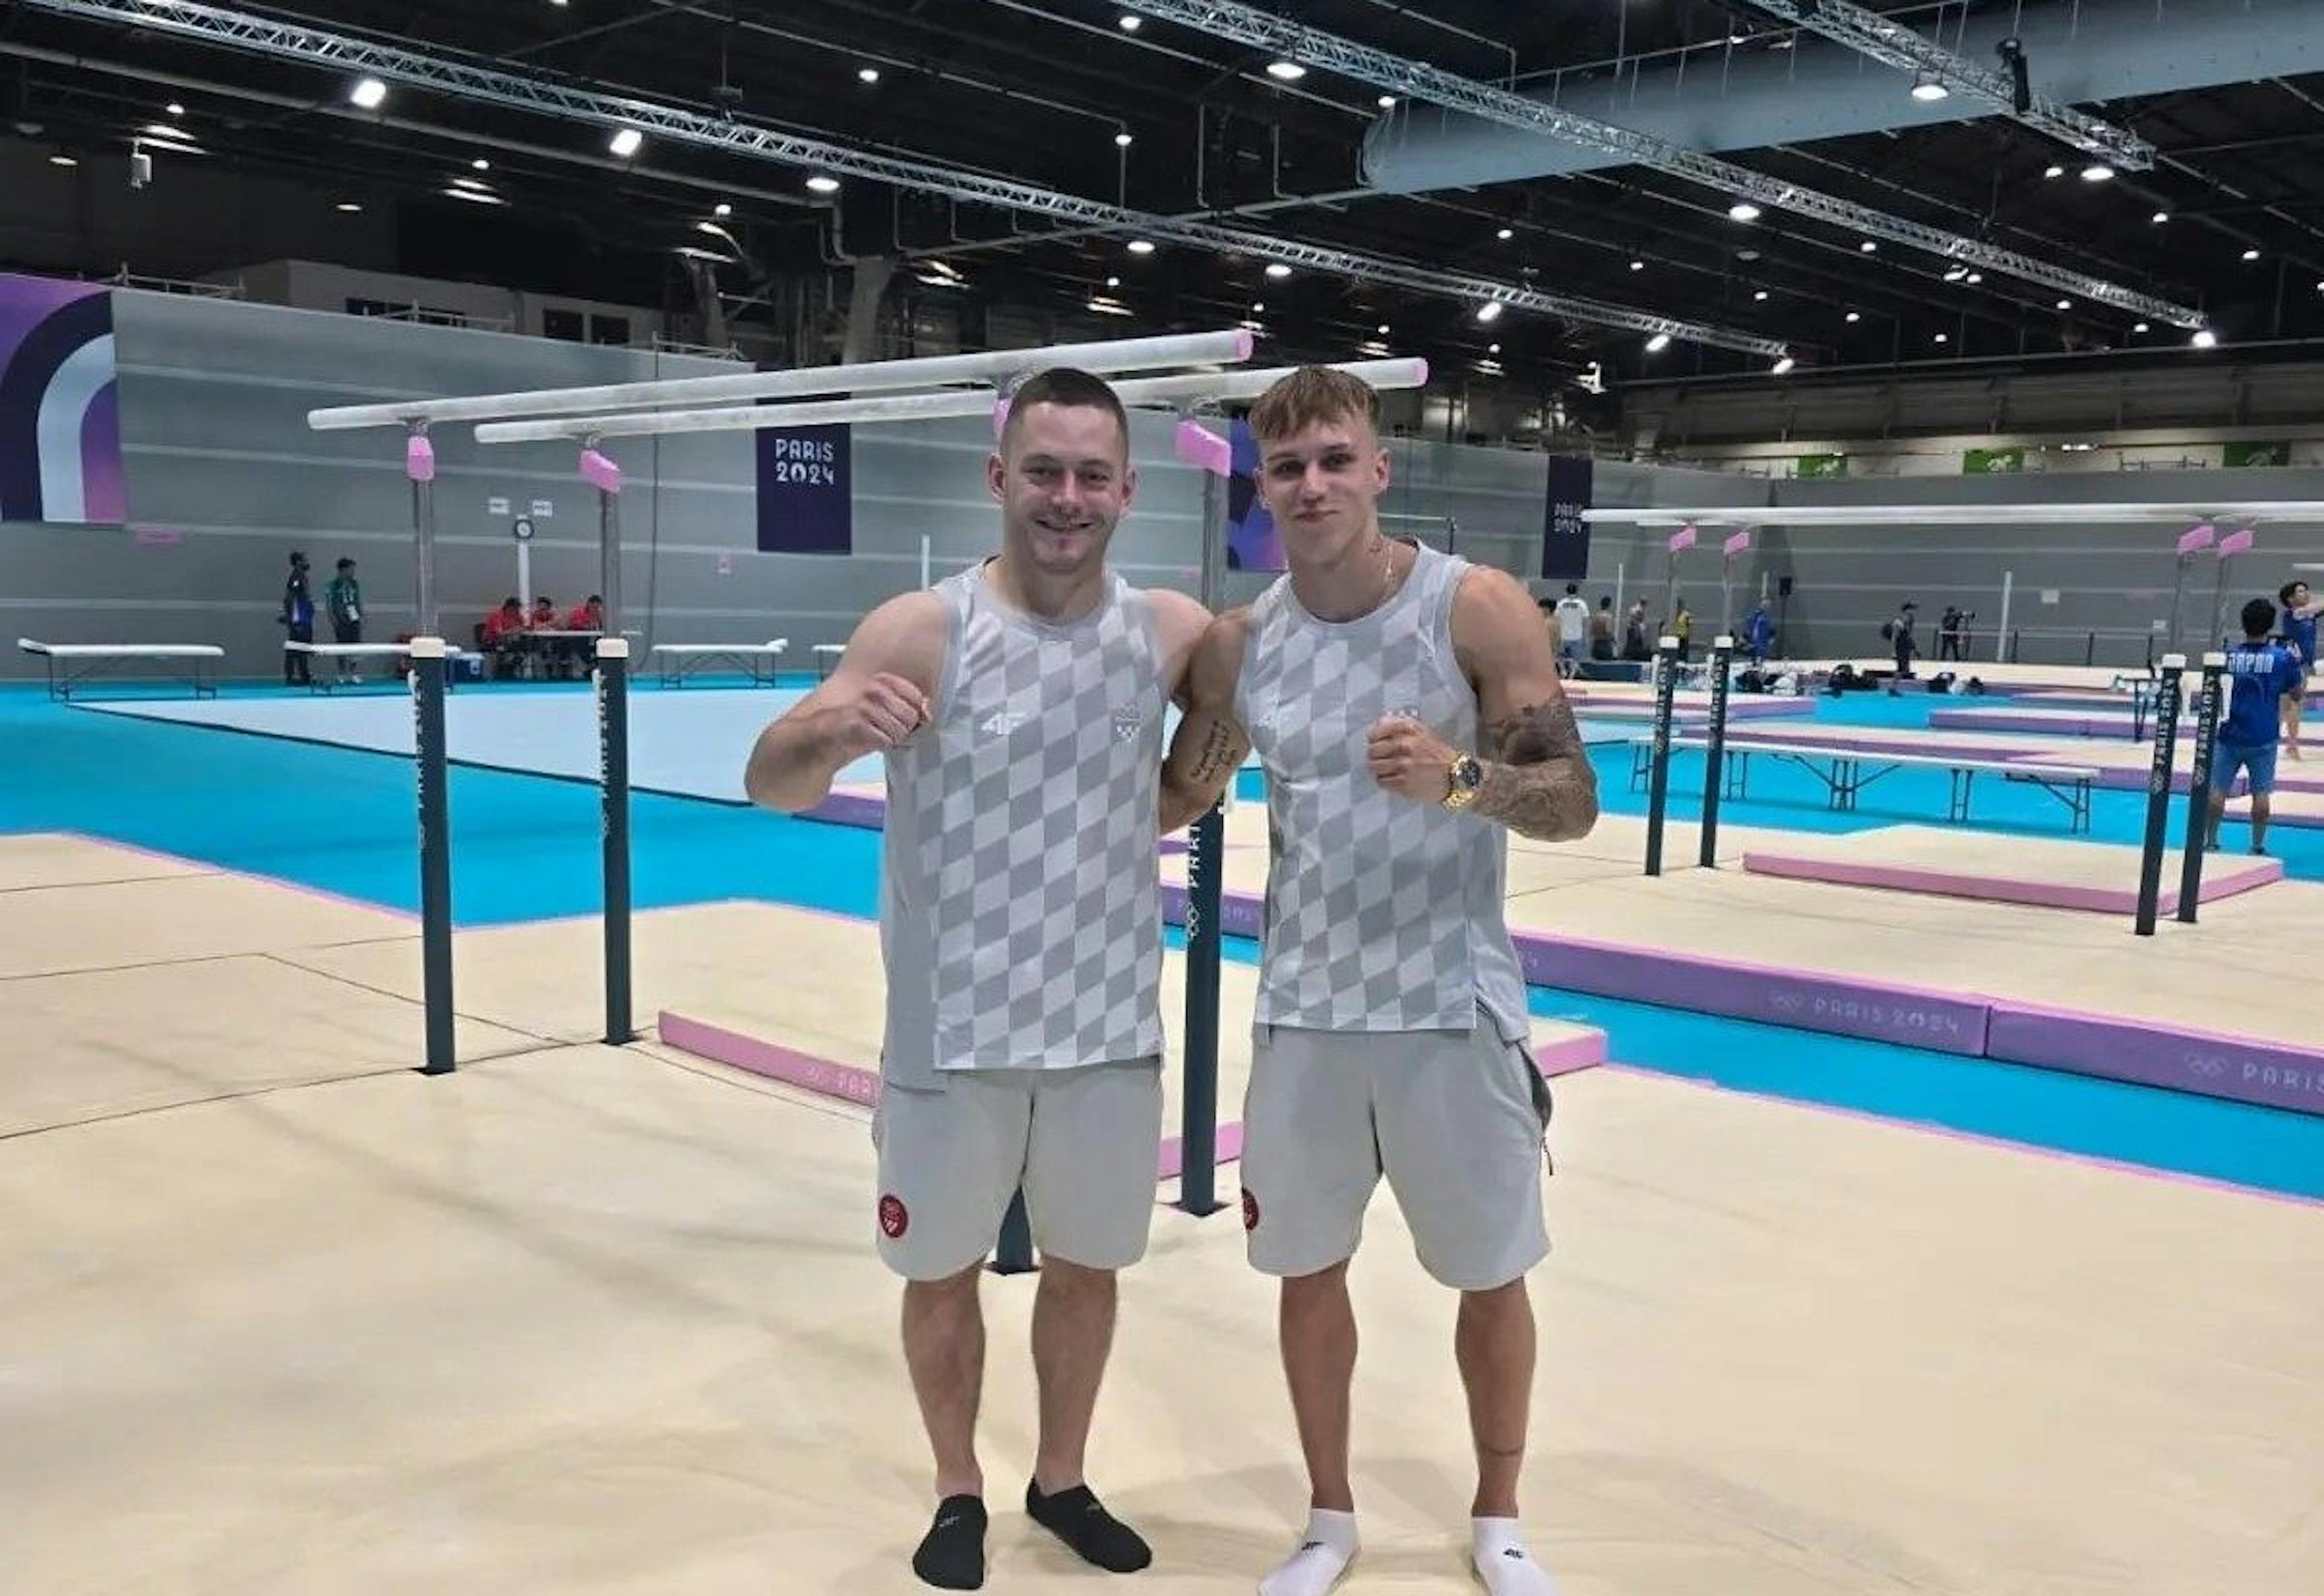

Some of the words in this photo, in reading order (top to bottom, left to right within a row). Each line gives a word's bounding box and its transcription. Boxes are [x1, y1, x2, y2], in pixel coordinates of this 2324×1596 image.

[775, 439, 834, 462] PARIS
[775, 461, 835, 485] 2024
[1189, 826, 1202, 888] PARI
[1816, 998, 1882, 1022] PARIS
[1893, 1010, 1958, 1033] 2024
